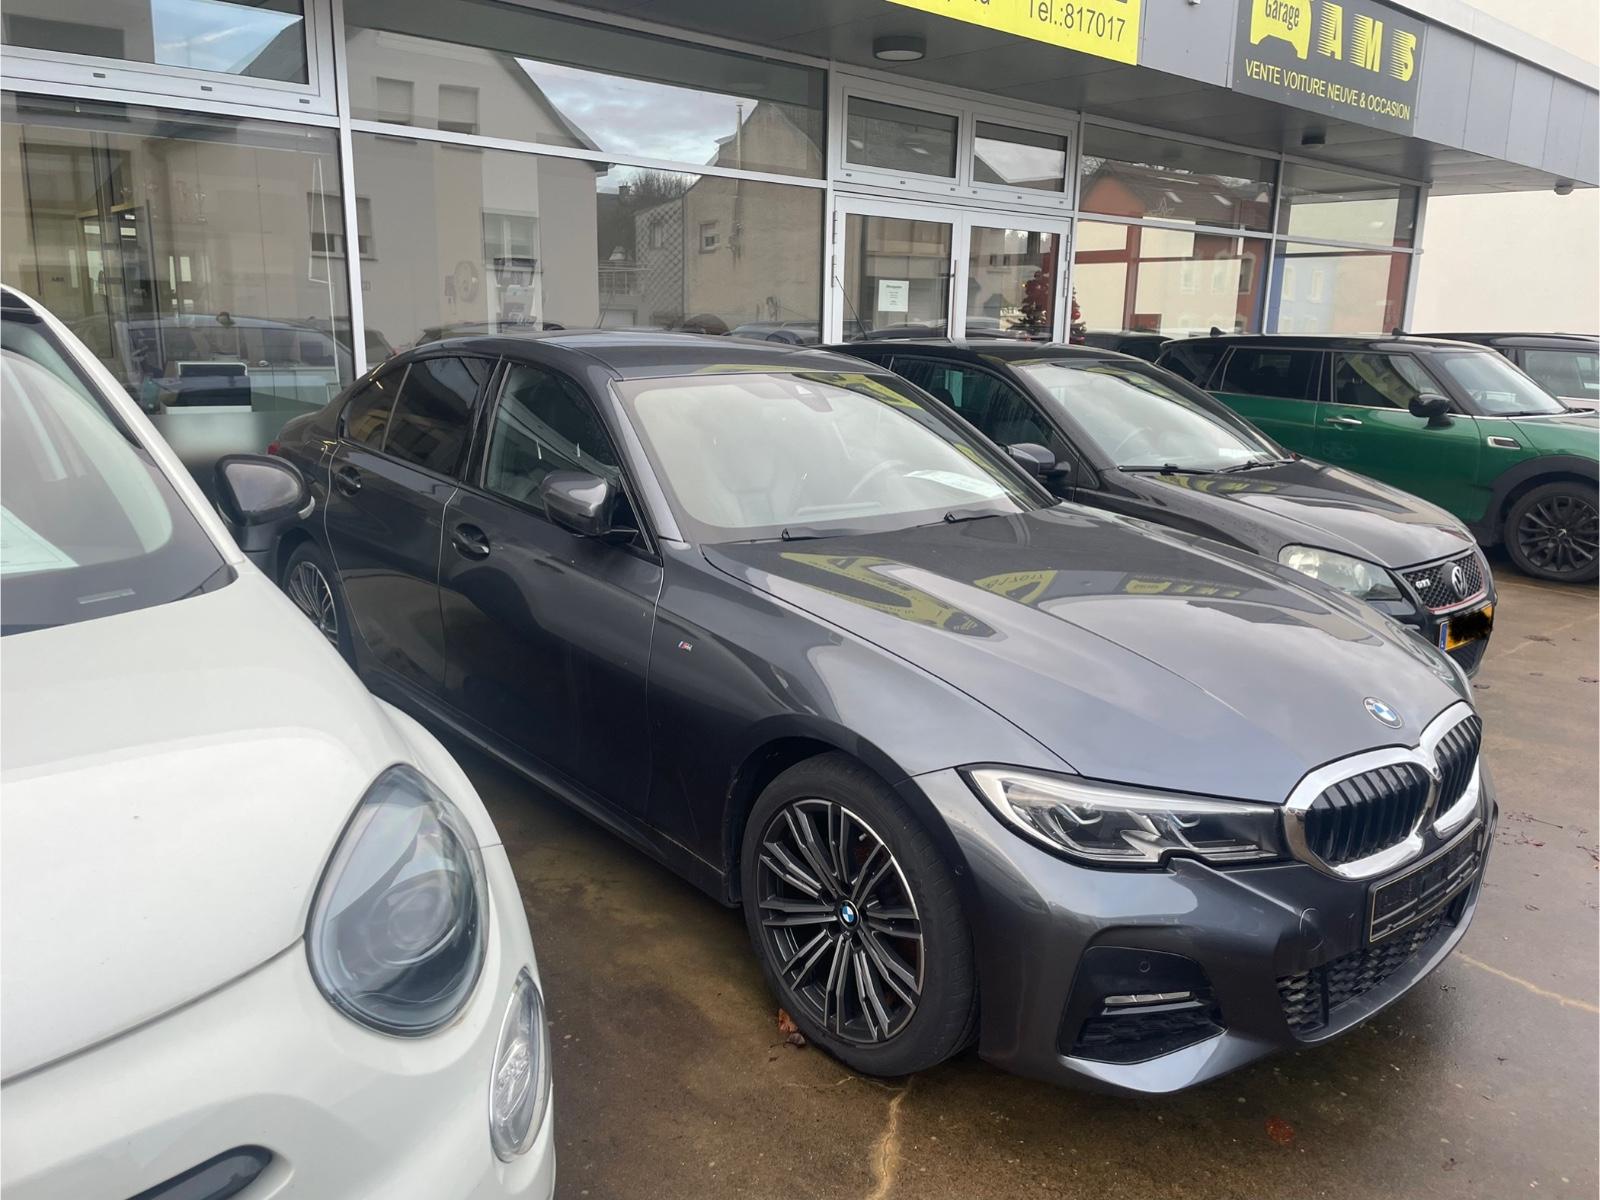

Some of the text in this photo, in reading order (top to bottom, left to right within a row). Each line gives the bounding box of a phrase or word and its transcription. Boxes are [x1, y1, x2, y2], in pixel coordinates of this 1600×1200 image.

[1265, 0, 1300, 30] Garage
[1245, 59, 1411, 120] VENTE VOITURE NEUVE & OCCASION
